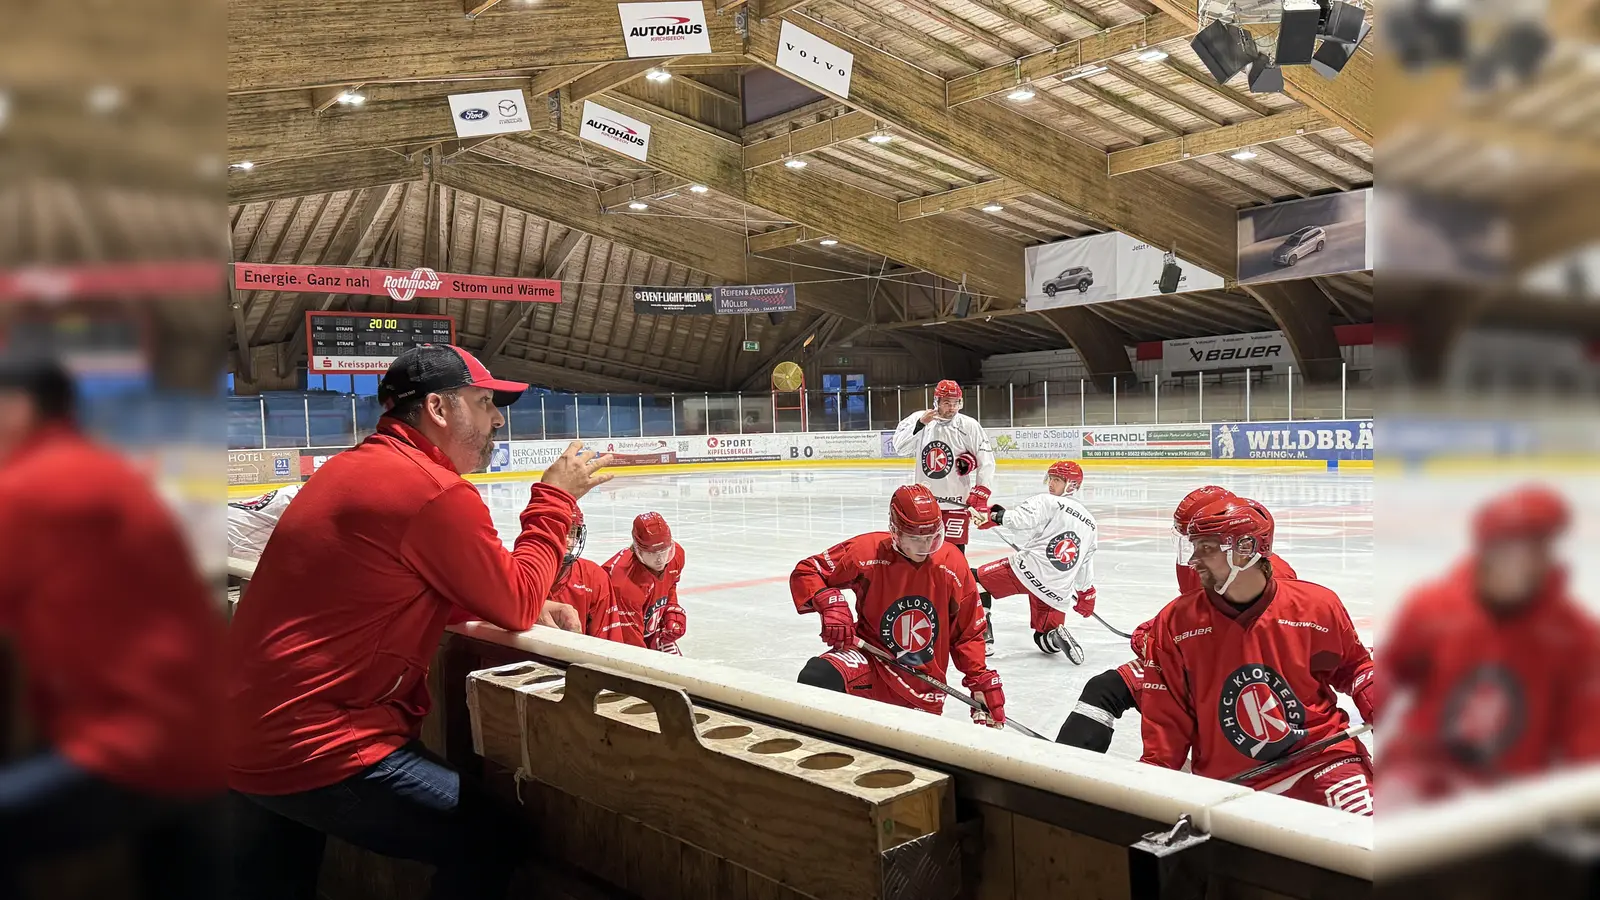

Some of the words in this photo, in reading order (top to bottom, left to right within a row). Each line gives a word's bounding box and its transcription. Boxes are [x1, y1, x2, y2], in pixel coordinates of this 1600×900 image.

[630, 24, 703, 37] AUTOHAUS
[785, 42, 846, 77] VOLVO
[465, 109, 484, 121] Ford
[586, 119, 645, 147] AUTOHAUS
[244, 270, 302, 287] Energie.
[307, 273, 341, 287] Ganz
[346, 275, 370, 288] nah
[383, 275, 443, 291] Rothmoser
[452, 280, 488, 294] Strom
[492, 283, 514, 295] und
[517, 284, 555, 297] Wärme
[1205, 345, 1282, 361] BAUER
[338, 360, 393, 369] Kreissparkas
[1043, 430, 1049, 439] &
[1050, 430, 1079, 439] Seibold
[1095, 433, 1145, 442] KERNDL
[720, 439, 752, 448] SPORT
[228, 453, 264, 462] HOTEL
[513, 448, 563, 457] BERGMEISTER
[790, 446, 799, 458] B
[803, 446, 813, 457] O
[1250, 451, 1287, 459] GRAFING
[1297, 451, 1308, 459] M.
[276, 460, 288, 468] 21
[1023, 571, 1064, 602] BAUER
[1278, 618, 1329, 633] SHERWOOD
[1313, 756, 1362, 780] SHERWOOD
